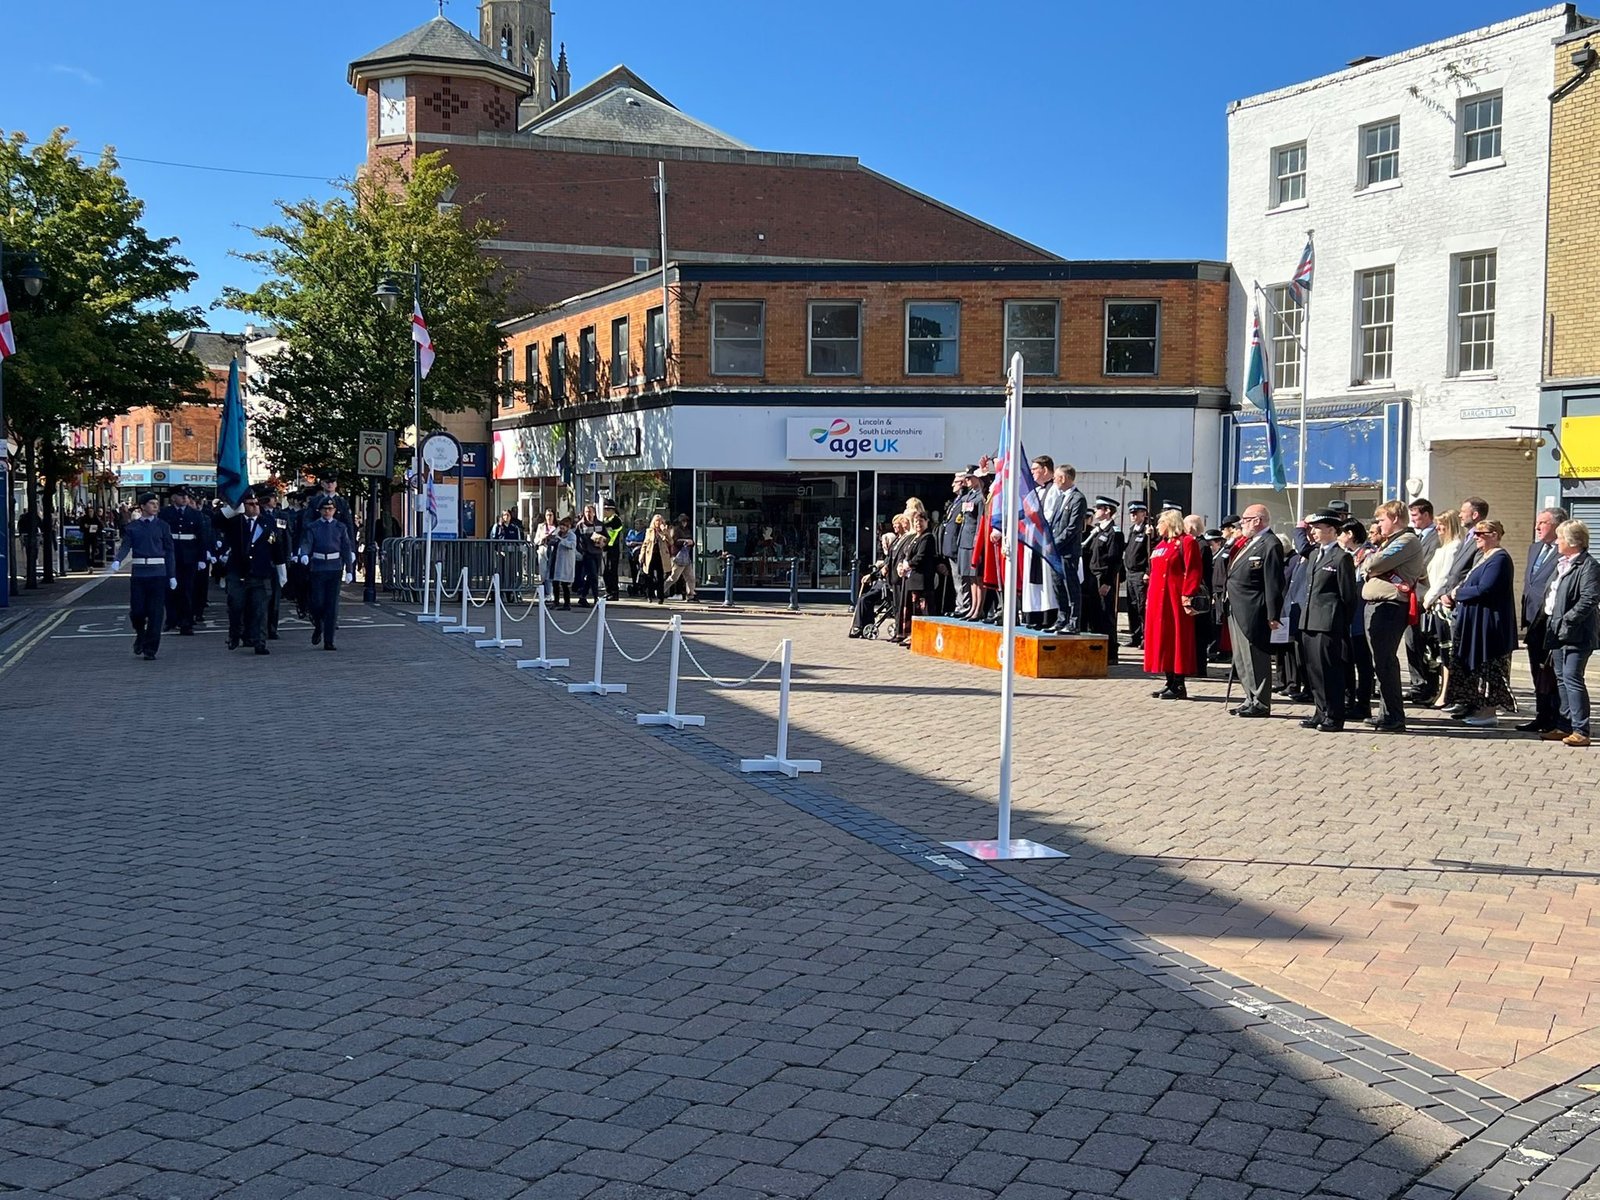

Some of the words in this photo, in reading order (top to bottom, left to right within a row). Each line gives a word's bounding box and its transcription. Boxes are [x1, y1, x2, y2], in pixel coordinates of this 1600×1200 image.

[1462, 409, 1493, 418] BARGATE
[1496, 408, 1513, 416] LANE
[858, 418, 884, 426] Lincoln
[886, 418, 892, 426] &
[881, 428, 923, 436] Lincolnshire
[364, 437, 382, 446] ZONE
[829, 438, 872, 459] age
[874, 438, 899, 453] UK
